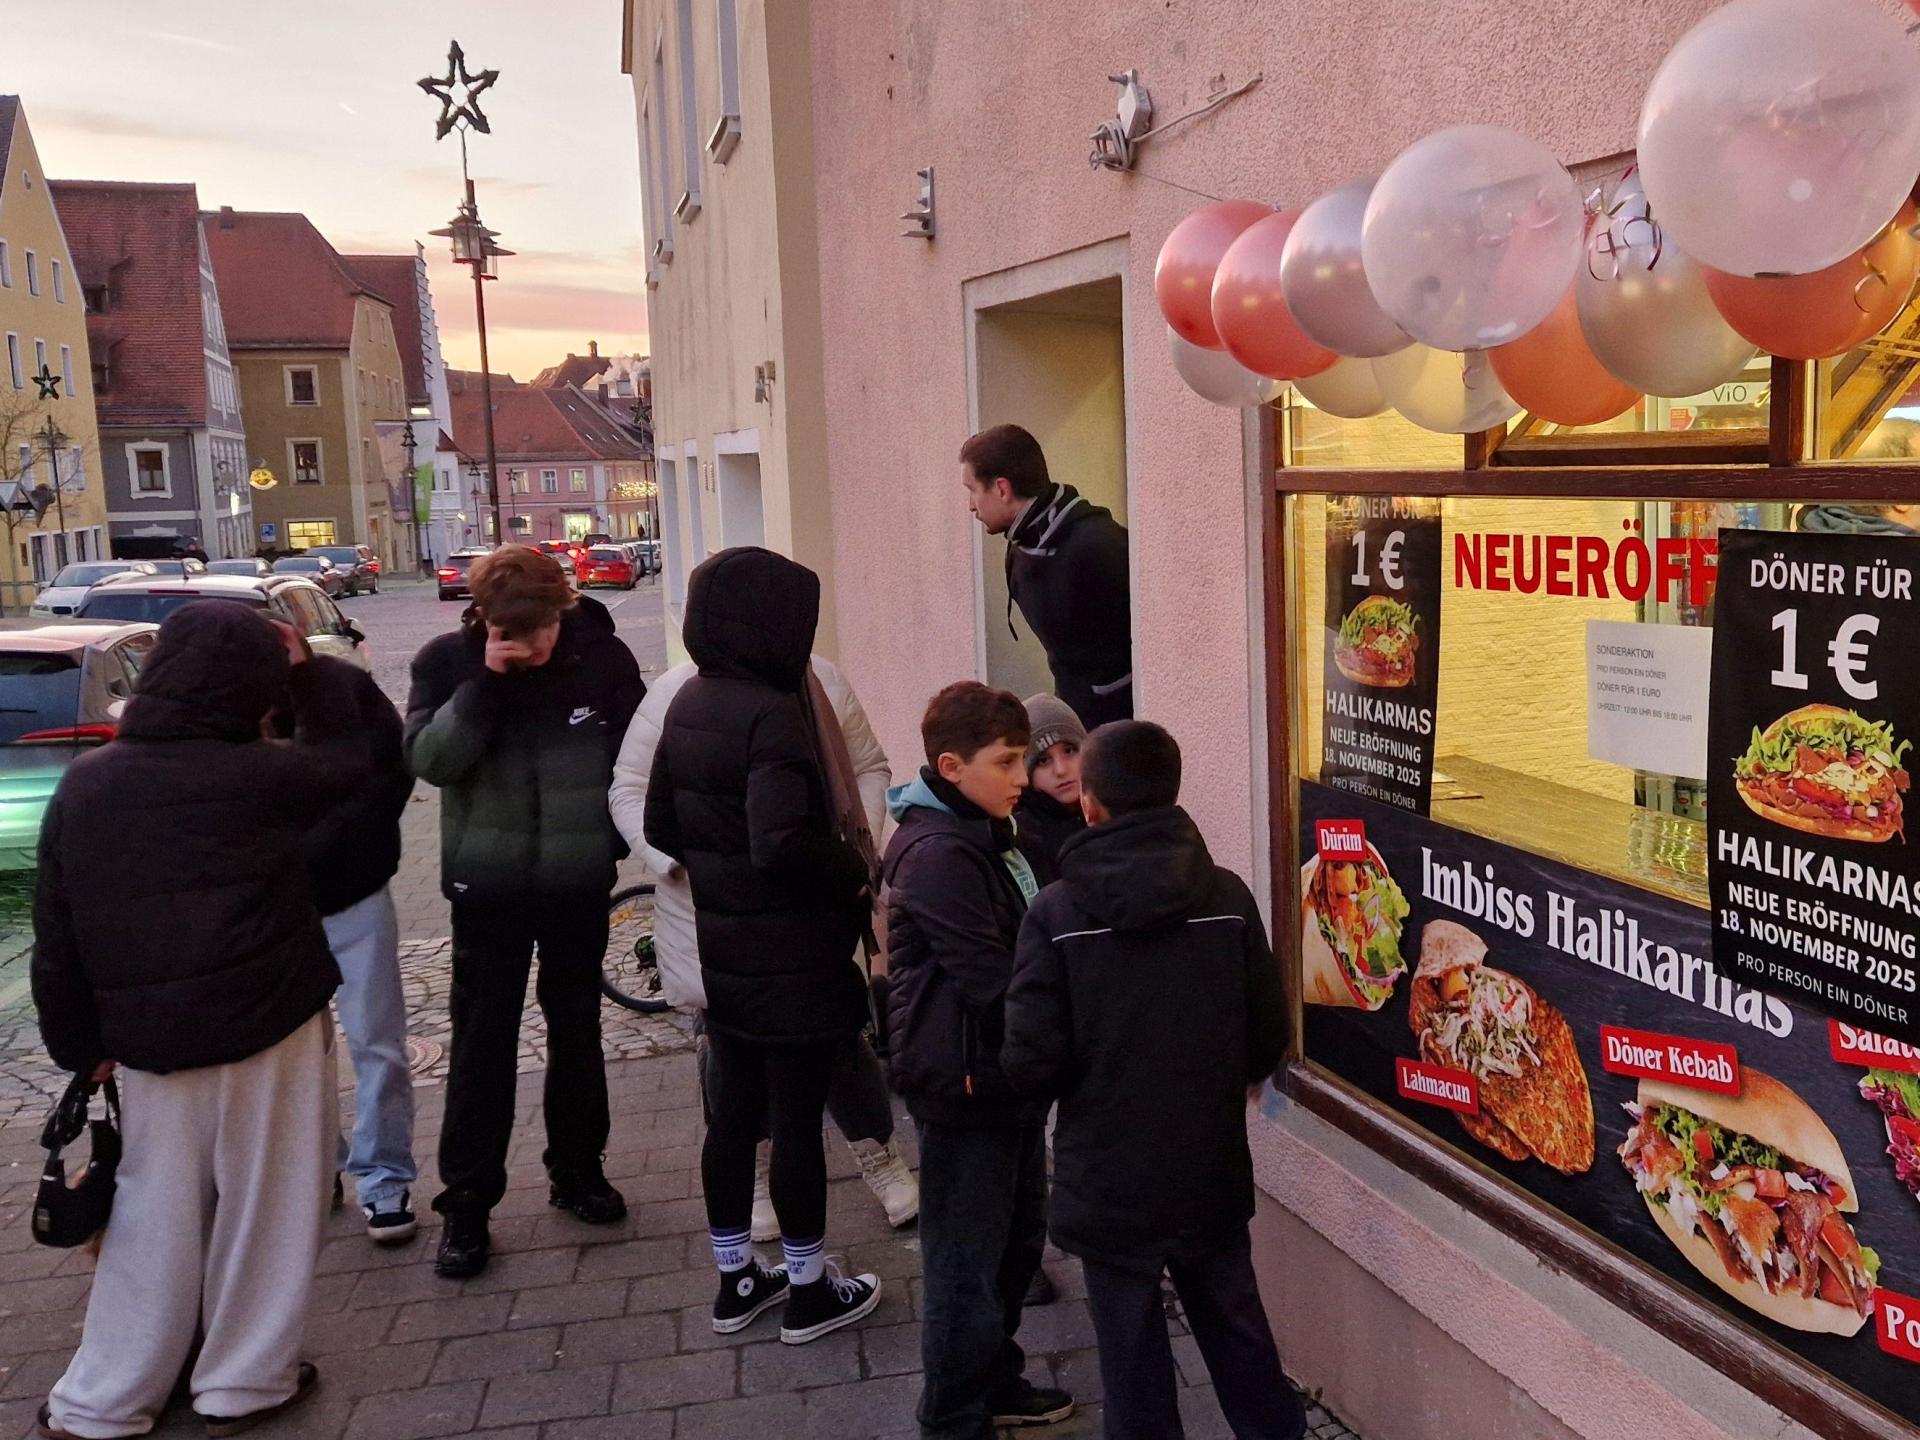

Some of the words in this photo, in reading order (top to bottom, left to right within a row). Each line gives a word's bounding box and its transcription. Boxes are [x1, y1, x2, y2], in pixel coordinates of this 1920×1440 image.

[1712, 385, 1747, 402] ViO
[1351, 530, 1370, 587] 1
[1379, 530, 1405, 590] €
[1455, 518, 1719, 606] NEUERÖFF
[1750, 553, 1845, 595] DÖNER
[1855, 559, 1912, 600] FÜR
[1596, 644, 1654, 659] SONDERAKTION
[1596, 664, 1608, 674] PRO
[1609, 665, 1634, 677] PERSON
[1634, 668, 1645, 677] EIN
[1645, 668, 1667, 680] DÖNER
[1771, 608, 1809, 690] 1
[1827, 613, 1880, 701] €
[1326, 689, 1432, 735] HALIKARNAS
[1597, 681, 1621, 693] DÖNER
[1621, 683, 1635, 695] FÜR
[1641, 687, 1661, 698] EURO
[1324, 747, 1337, 763] 18.
[1339, 751, 1395, 778] NOVEMBER
[1397, 765, 1421, 787] 2025
[1330, 727, 1357, 745] NEUE
[1359, 731, 1421, 763] ERÖFFNUNG
[1332, 776, 1348, 790] PRO
[1349, 779, 1378, 797] PERSON
[1379, 788, 1391, 802] EIN
[1392, 792, 1416, 810] DÖNER
[1320, 827, 1362, 852] Dürüm
[1420, 846, 1535, 938] Imbiss
[1547, 891, 1793, 1038] Halikarnas
[1728, 881, 1780, 916] NEUE
[1786, 898, 1916, 959] ERÖFFNUNG
[1720, 909, 1745, 935] 18.
[1750, 917, 1859, 974] NOVEMBER
[1865, 955, 1916, 993] 2025
[1737, 951, 1764, 974] PRO
[1769, 962, 1822, 995] PERSON
[1827, 983, 1849, 1005] EIN
[1854, 993, 1908, 1025] DÖNER
[1607, 1036, 1663, 1071] Döner
[1667, 1046, 1733, 1083] Kebab
[1402, 1066, 1470, 1104] Lahmacun
